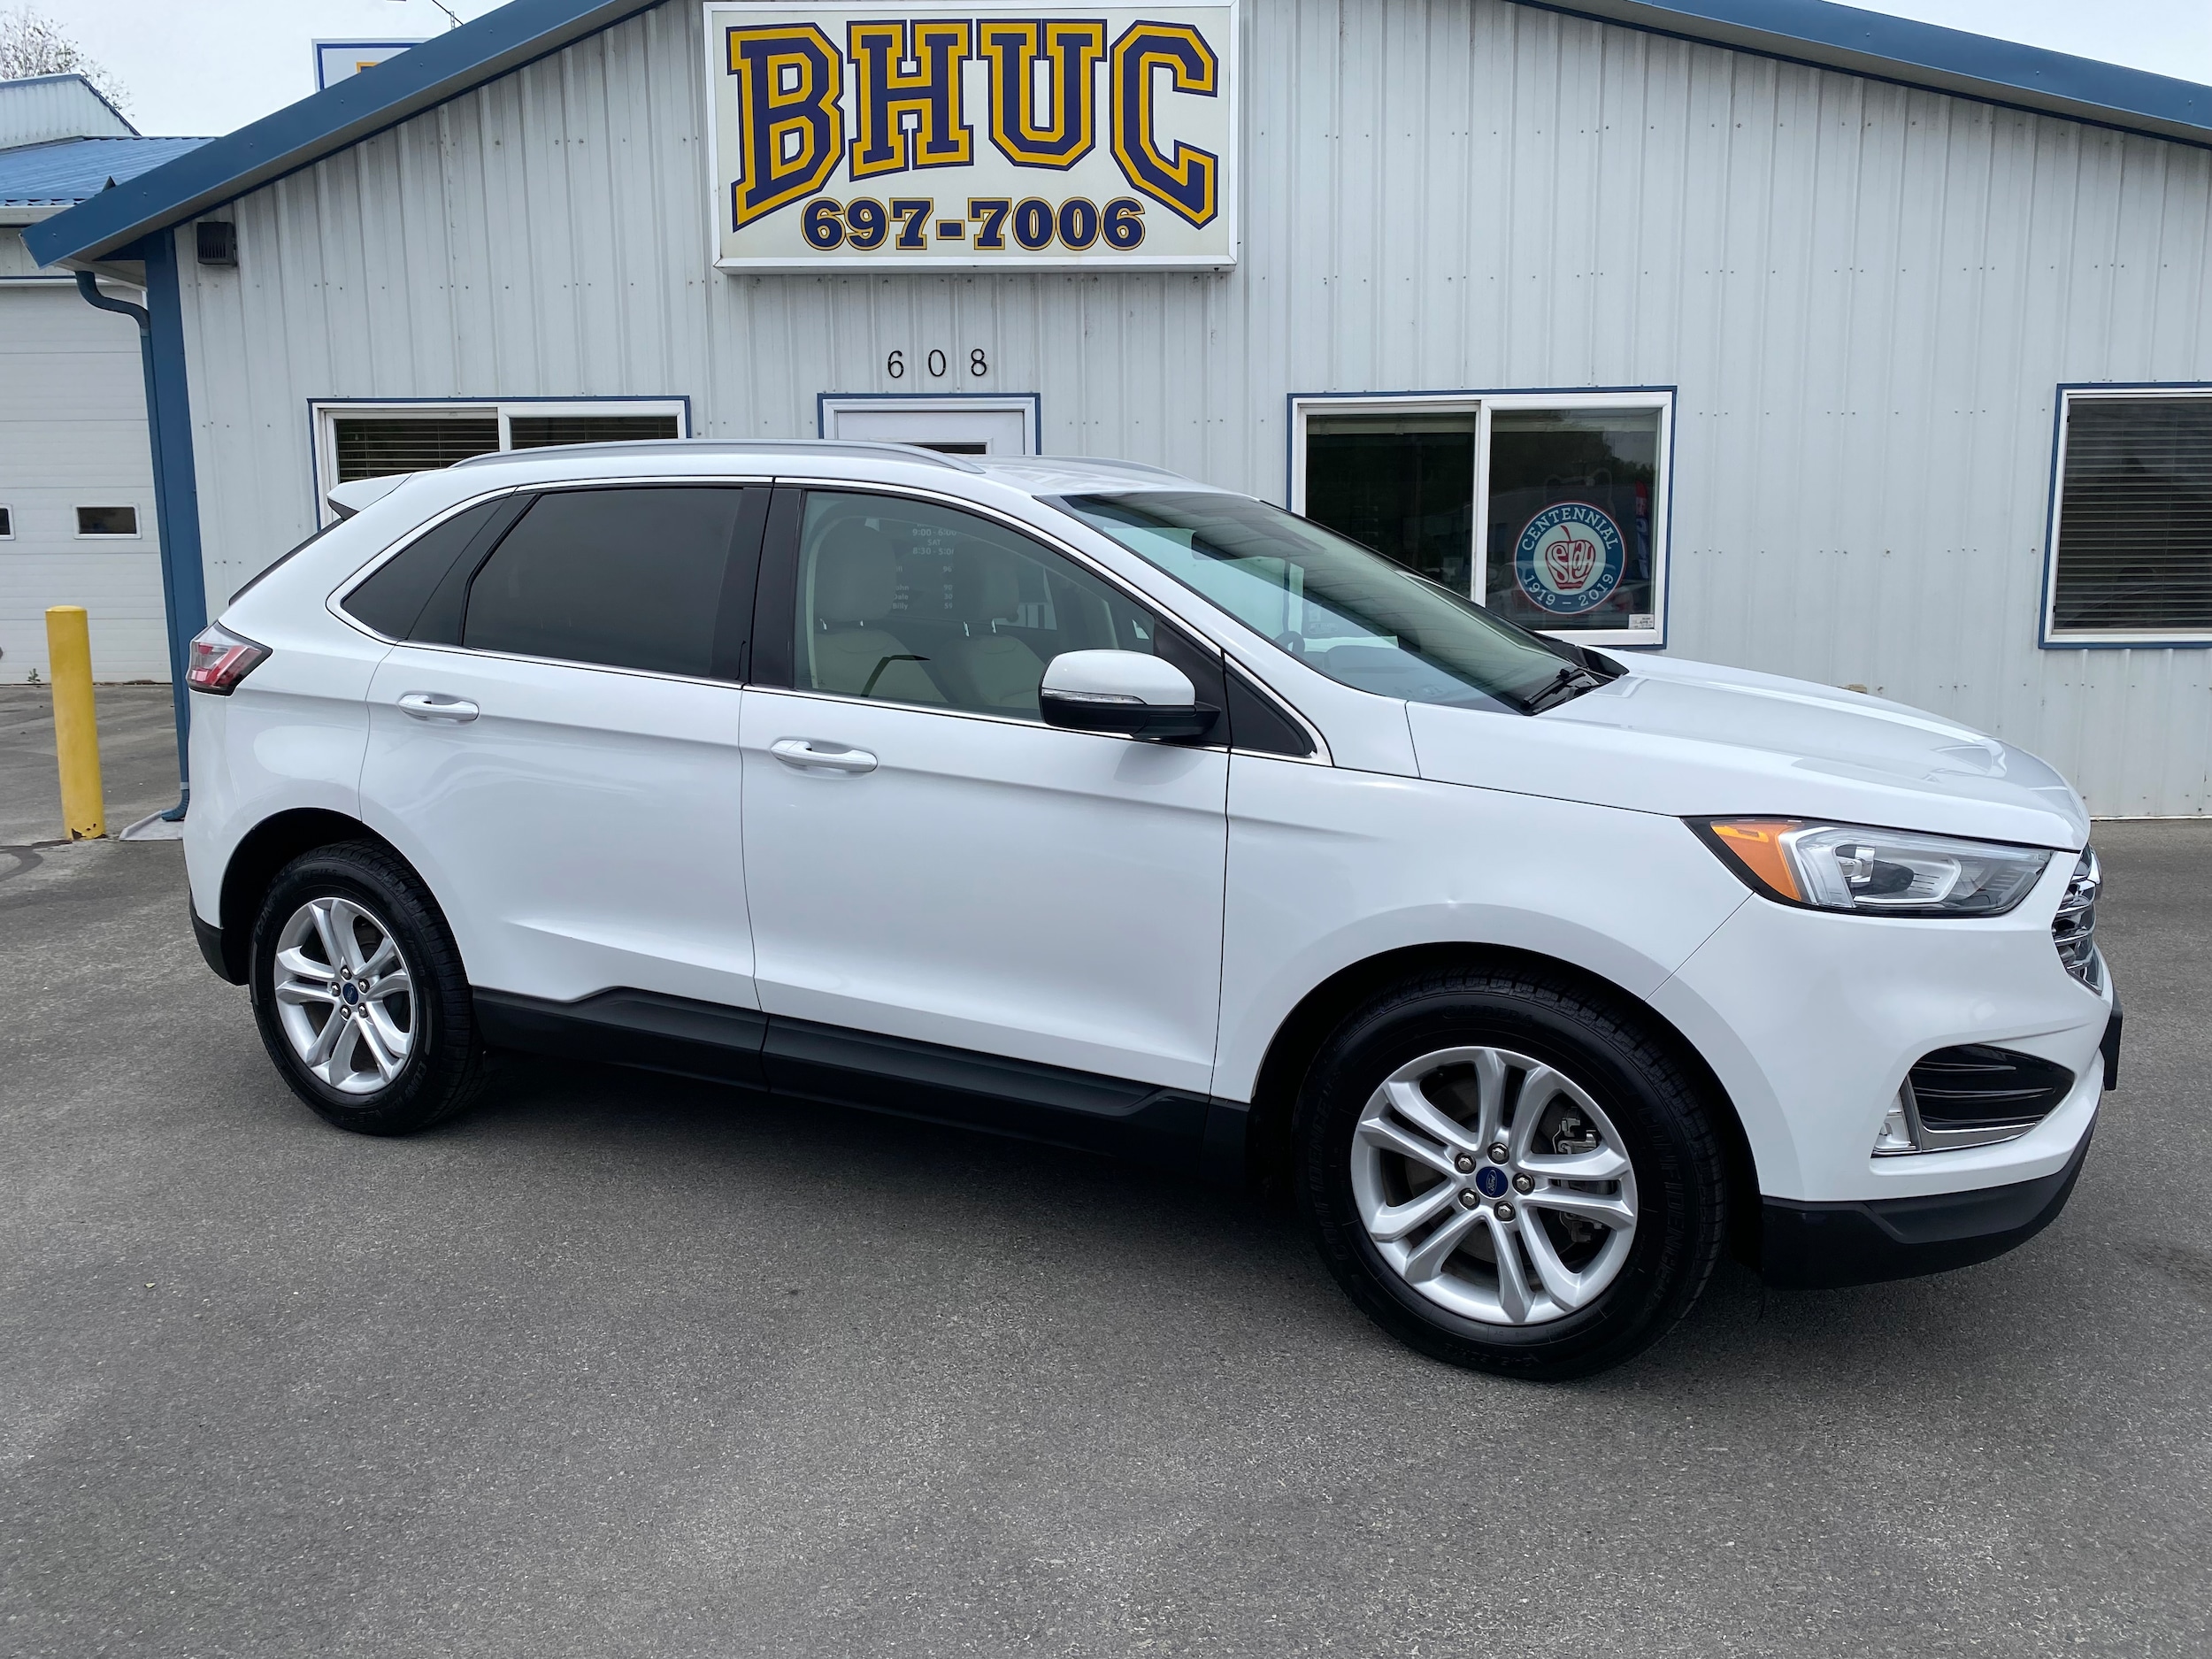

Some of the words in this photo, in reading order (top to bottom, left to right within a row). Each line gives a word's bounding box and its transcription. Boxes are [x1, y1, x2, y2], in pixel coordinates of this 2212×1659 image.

[726, 19, 1218, 232] BHUC
[800, 196, 1145, 251] 697-7006
[1522, 507, 1619, 551] CENTENNIAL
[1523, 575, 1555, 606] 1919
[1578, 573, 1613, 607] 2019
